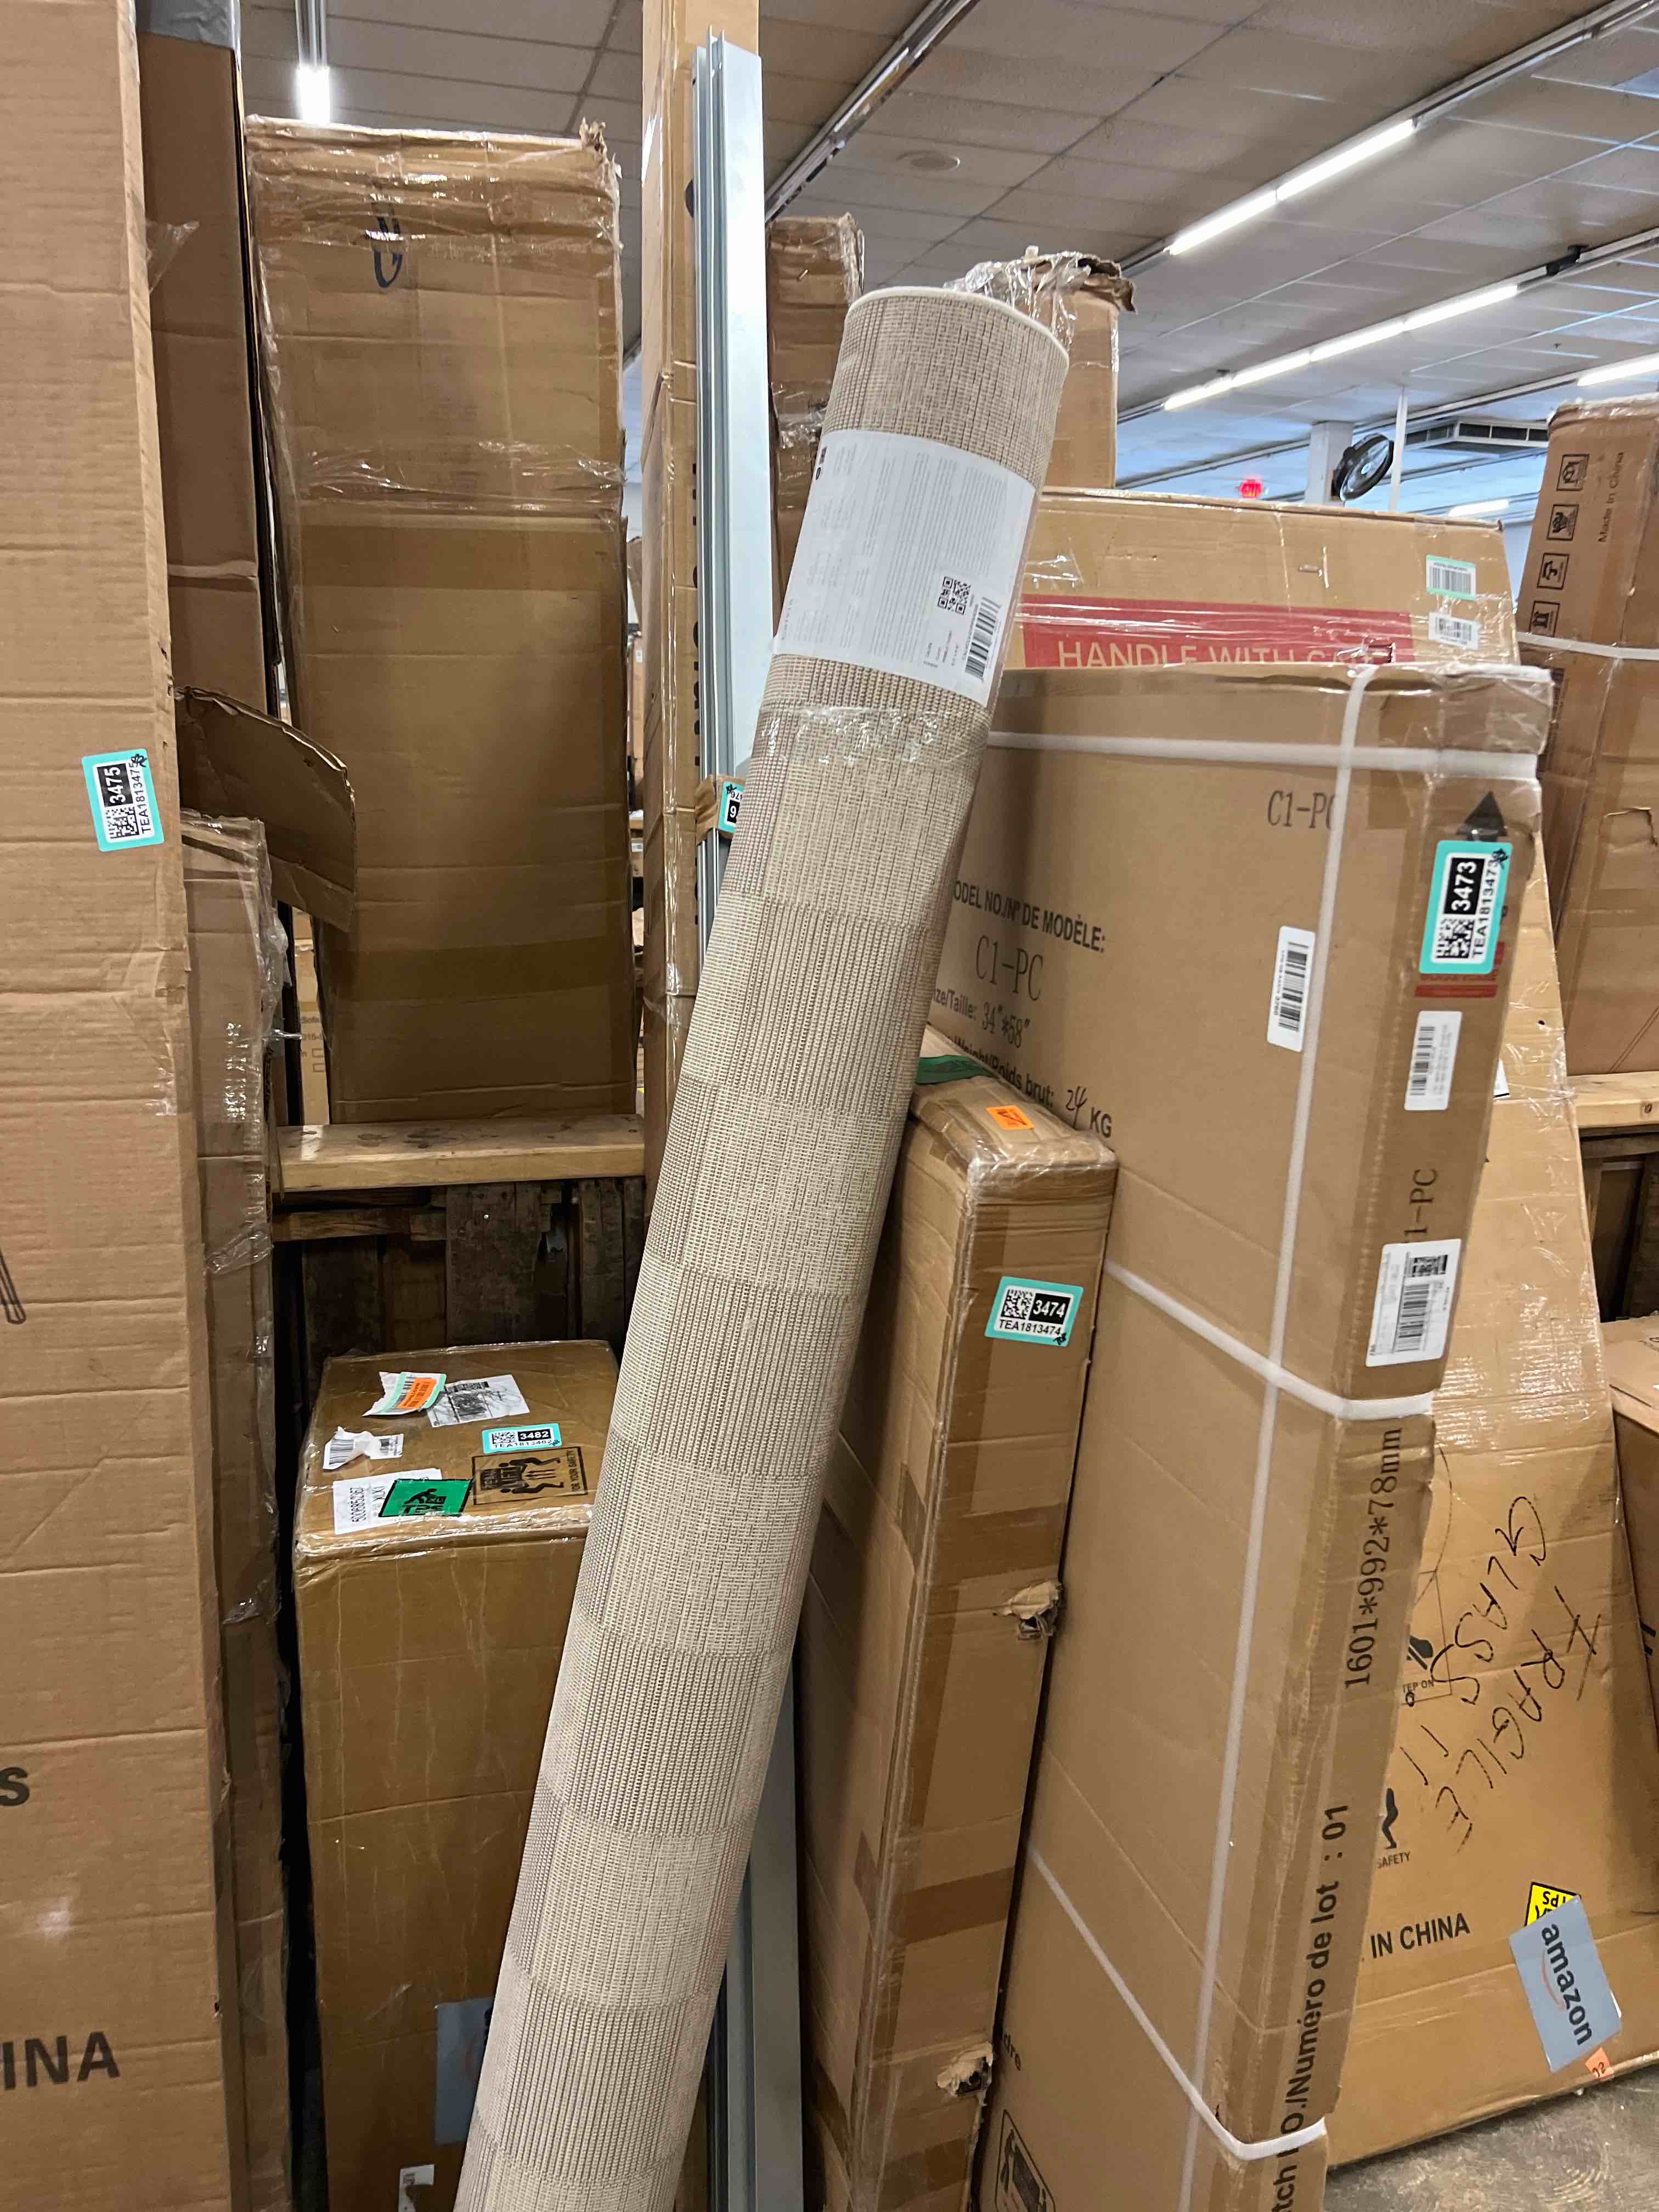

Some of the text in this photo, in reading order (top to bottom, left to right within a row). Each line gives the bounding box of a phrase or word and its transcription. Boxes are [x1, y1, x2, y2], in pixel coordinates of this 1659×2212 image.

[1058, 640, 1197, 668] HANDLE
[104, 767, 126, 804] 3475
[129, 761, 151, 834] TEA1813475
[953, 880, 982, 909] ODEL
[1022, 902, 1041, 929] DE
[1451, 861, 1477, 912] 3473
[976, 935, 1043, 1001] C1-PC
[1090, 1107, 1112, 1138] KG
[1404, 1169, 1438, 1238] 1-PC
[999, 1319, 1062, 1336] TEA1813474
[1032, 1299, 1067, 1318] 3474
[519, 1431, 549, 1440] 3482
[1322, 1804, 1348, 1841] 01
[1310, 1880, 1340, 1924] lot
[1305, 1931, 1333, 1970] de
[1370, 1912, 1470, 1959] IN CHINA
[1541, 1923, 1593, 2046] amazon
